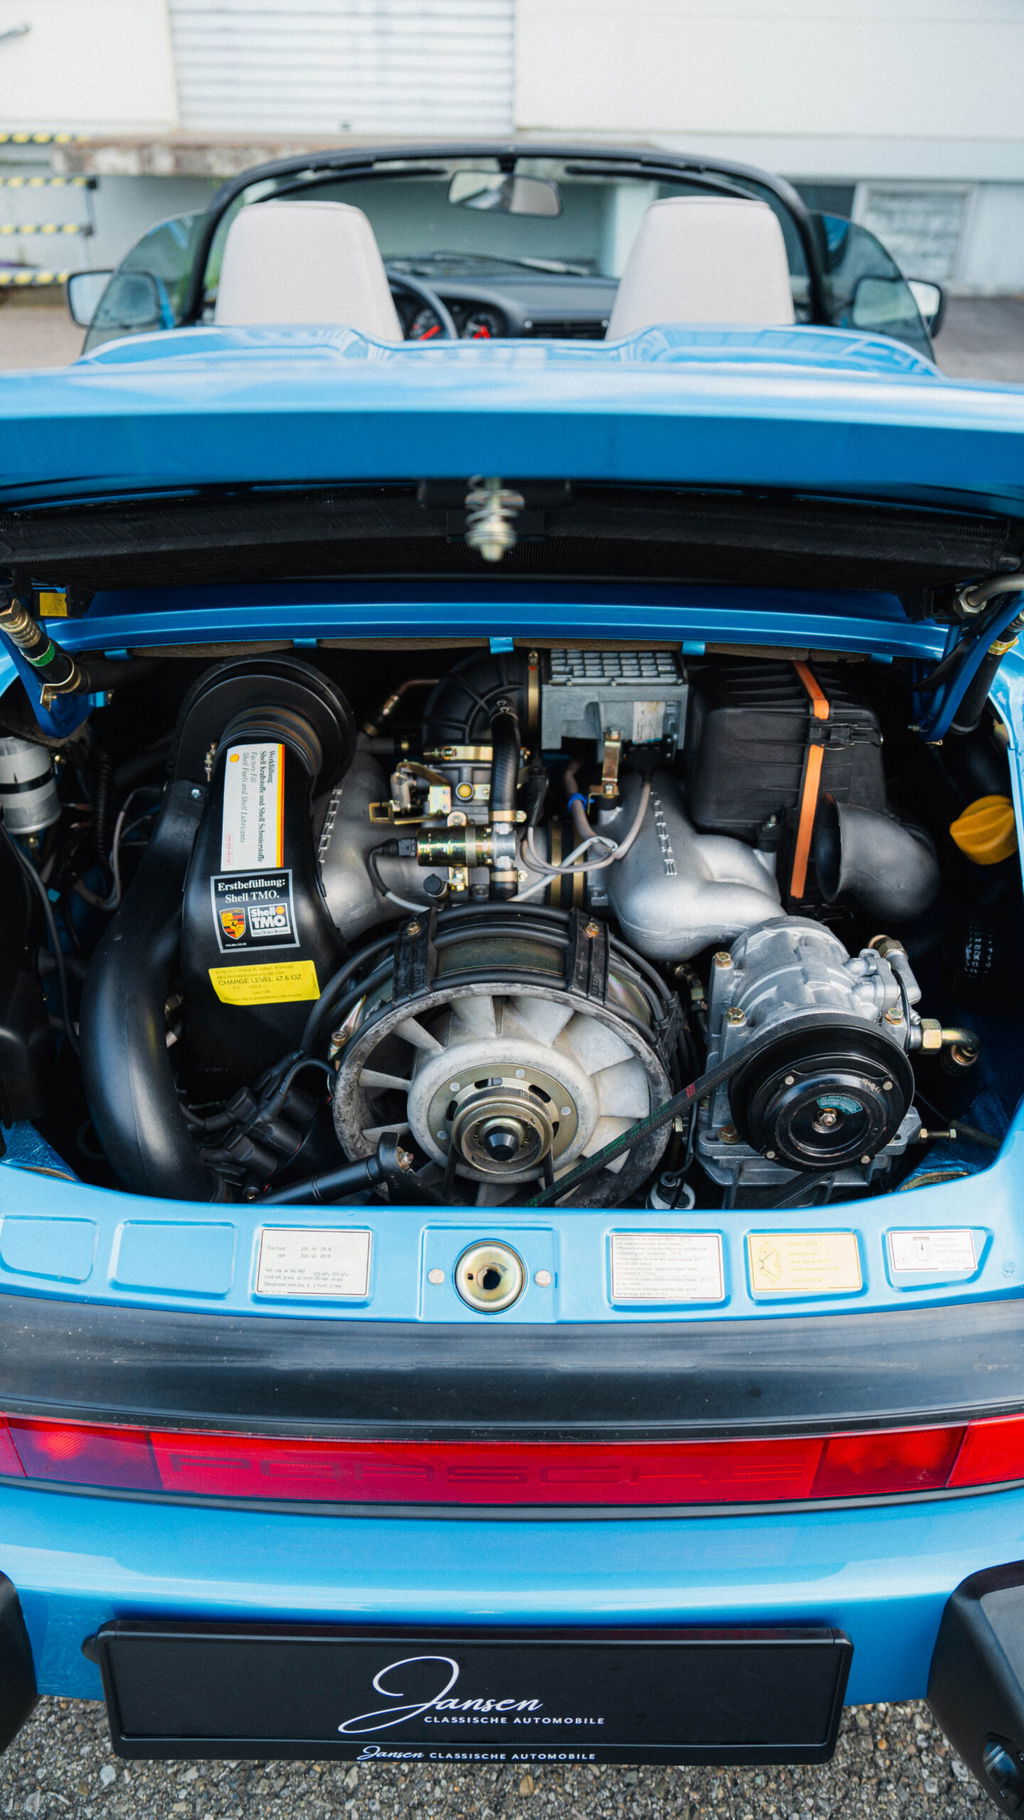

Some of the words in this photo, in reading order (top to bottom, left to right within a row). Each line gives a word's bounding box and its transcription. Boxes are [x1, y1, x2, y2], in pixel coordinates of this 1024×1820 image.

[250, 751, 258, 772] Factory
[241, 767, 249, 782] Fuels
[259, 766, 267, 793] Kraftstoffe
[240, 795, 248, 810] Shell
[240, 811, 248, 843] Lubricants
[217, 878, 286, 892] Erstbefüllung:
[225, 893, 249, 904] Shell
[250, 889, 280, 901] TMO.
[251, 905, 276, 917] Shell
[252, 914, 286, 929] TMO
[218, 978, 249, 986] CHARGE
[168, 1453, 807, 1485] PORSCHE
[338, 1655, 543, 1733] Jansen
[424, 1716, 508, 1724] CLASSISCHE
[513, 1716, 605, 1725] AUTOMOBILE
[357, 1745, 424, 1761] Jansen
[429, 1752, 506, 1760] CLASSISCHE
[511, 1753, 596, 1761] AUTOMOBILE
